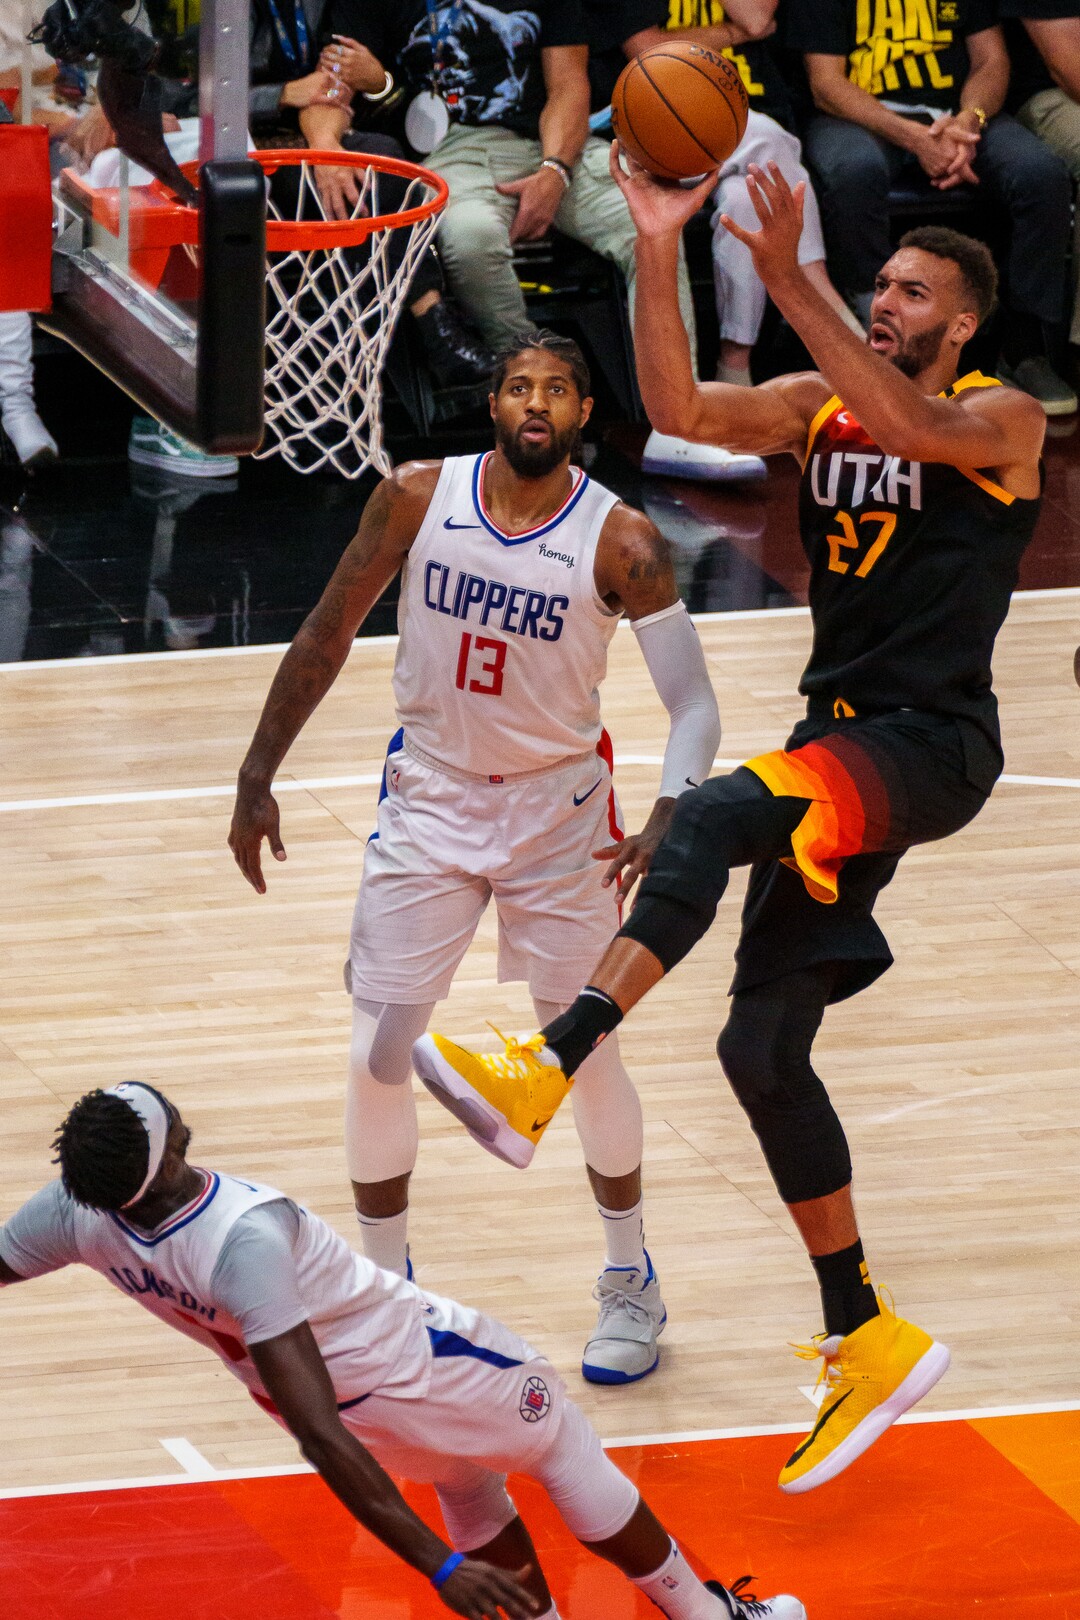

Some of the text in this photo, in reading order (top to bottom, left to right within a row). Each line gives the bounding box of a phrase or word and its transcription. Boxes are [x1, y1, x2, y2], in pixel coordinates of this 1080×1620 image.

[811, 452, 922, 511] UTAH
[538, 543, 575, 568] honey
[826, 510, 897, 578] 27
[424, 559, 569, 642] CLIPPERS
[455, 631, 508, 696] 13
